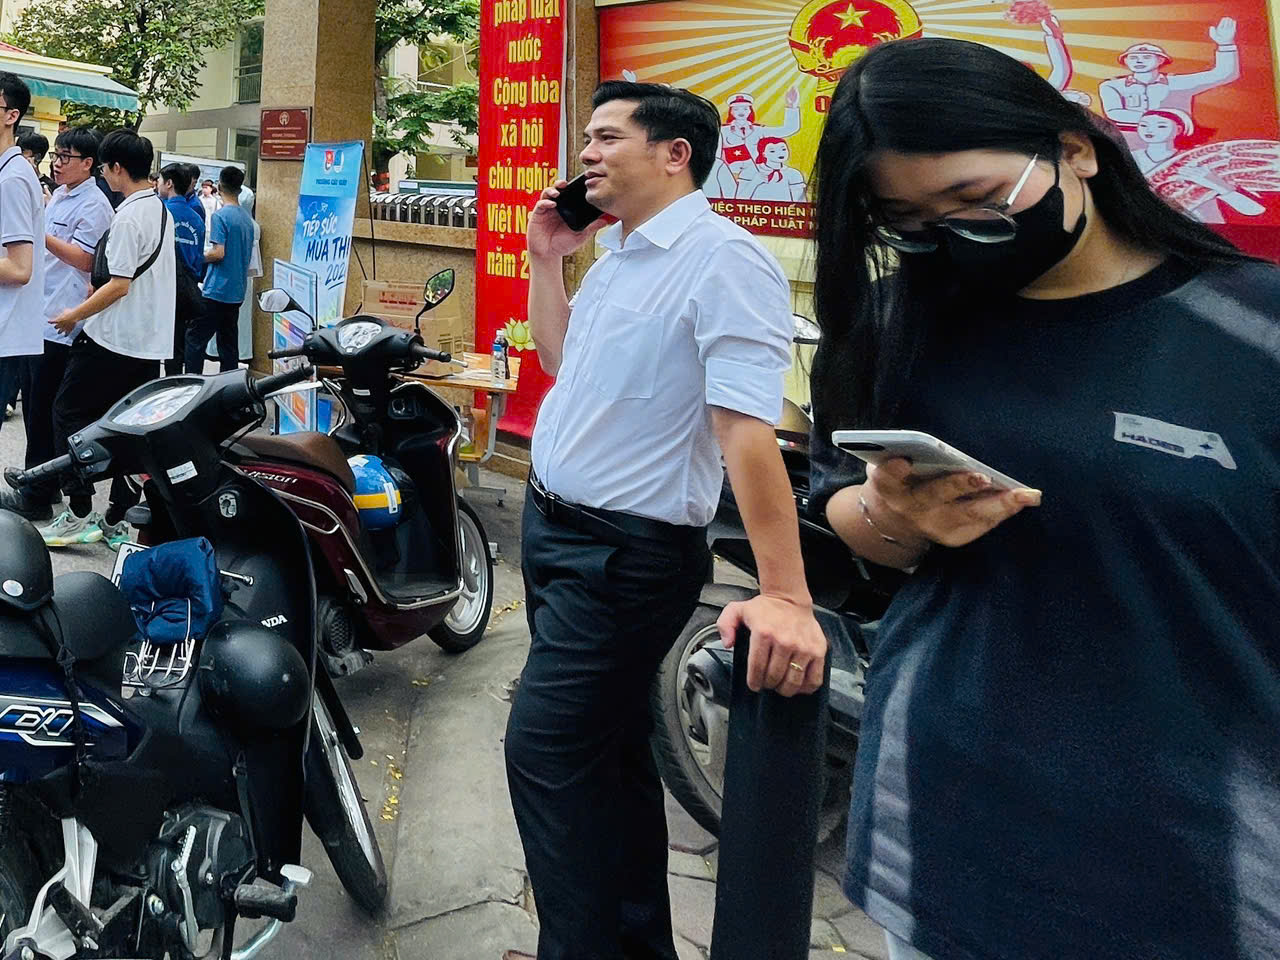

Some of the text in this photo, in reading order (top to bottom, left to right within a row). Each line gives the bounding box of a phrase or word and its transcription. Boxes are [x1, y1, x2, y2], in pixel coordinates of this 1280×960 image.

[508, 36, 542, 64] nước
[493, 77, 560, 108] Cộng hòa
[500, 118, 543, 148] xã hội
[489, 157, 559, 194] chủ nghĩa
[487, 203, 512, 239] Việt
[733, 215, 768, 227] PHÁP
[771, 218, 805, 231] LUẬT
[736, 204, 771, 215] THEO
[774, 203, 806, 216] HIẾN
[321, 212, 338, 236] SỨC
[332, 235, 351, 261] THI
[325, 262, 345, 286] 202
[487, 246, 516, 278] năm
[261, 615, 288, 628] NDA
